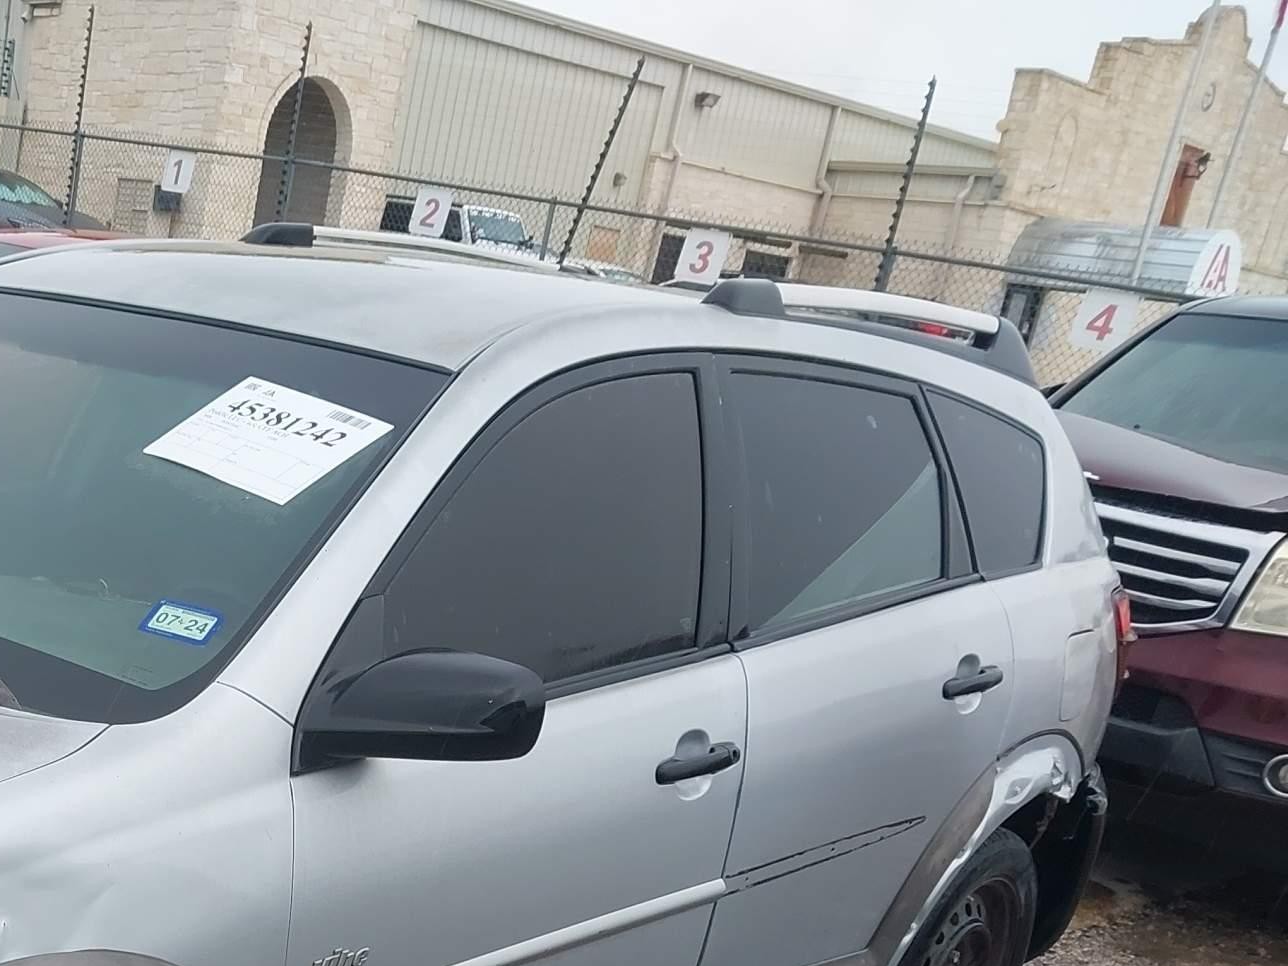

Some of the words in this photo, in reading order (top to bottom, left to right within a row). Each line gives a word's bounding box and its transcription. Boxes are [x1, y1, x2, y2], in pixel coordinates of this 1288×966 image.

[173, 159, 183, 185] 1
[419, 198, 441, 229] 2
[689, 240, 714, 274] 3
[1085, 304, 1118, 341] 4
[228, 399, 347, 447] 45381242
